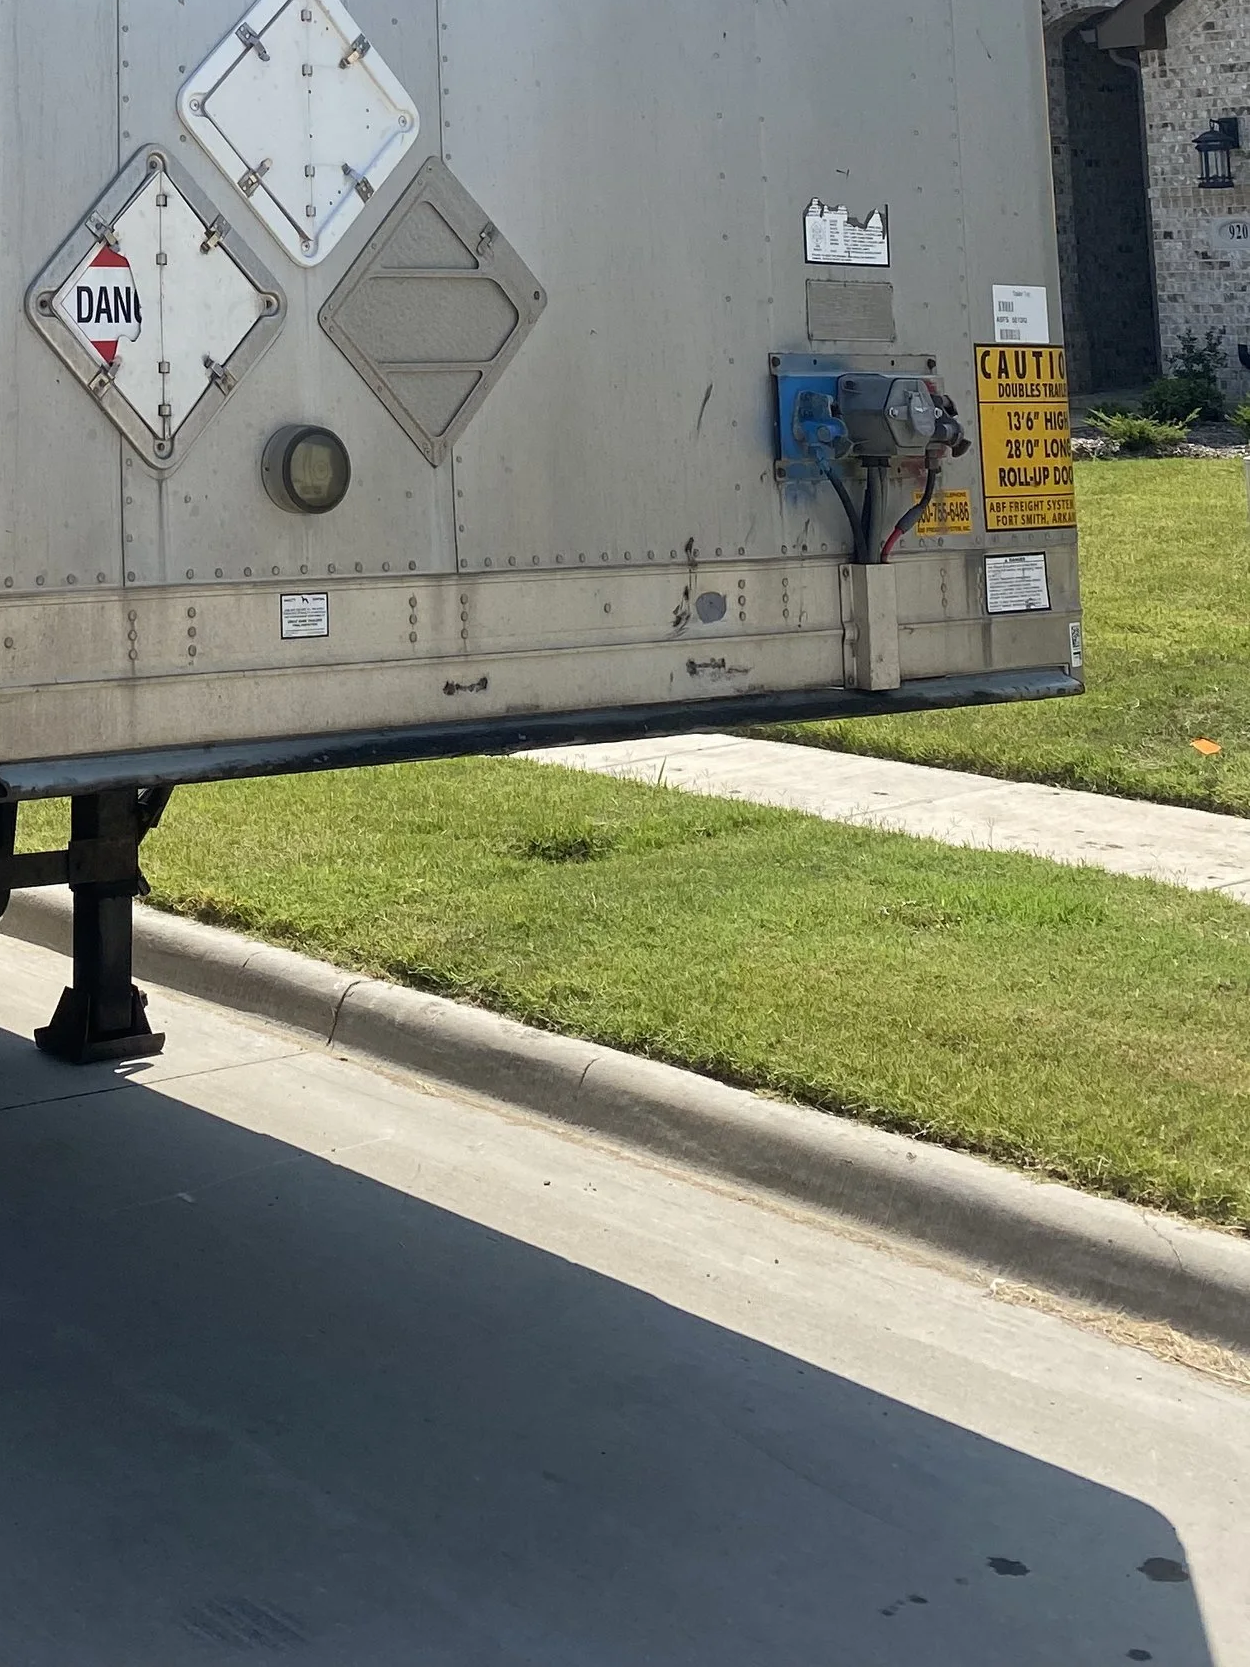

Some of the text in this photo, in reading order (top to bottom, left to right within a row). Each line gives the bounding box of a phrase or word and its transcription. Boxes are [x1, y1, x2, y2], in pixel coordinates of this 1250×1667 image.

[999, 383, 1041, 398] DOUBLES
[999, 467, 1050, 488] ROLL-UP
[989, 502, 1007, 513] ABF
[1009, 500, 1044, 512] FREIGHT
[996, 514, 1019, 526] FORT
